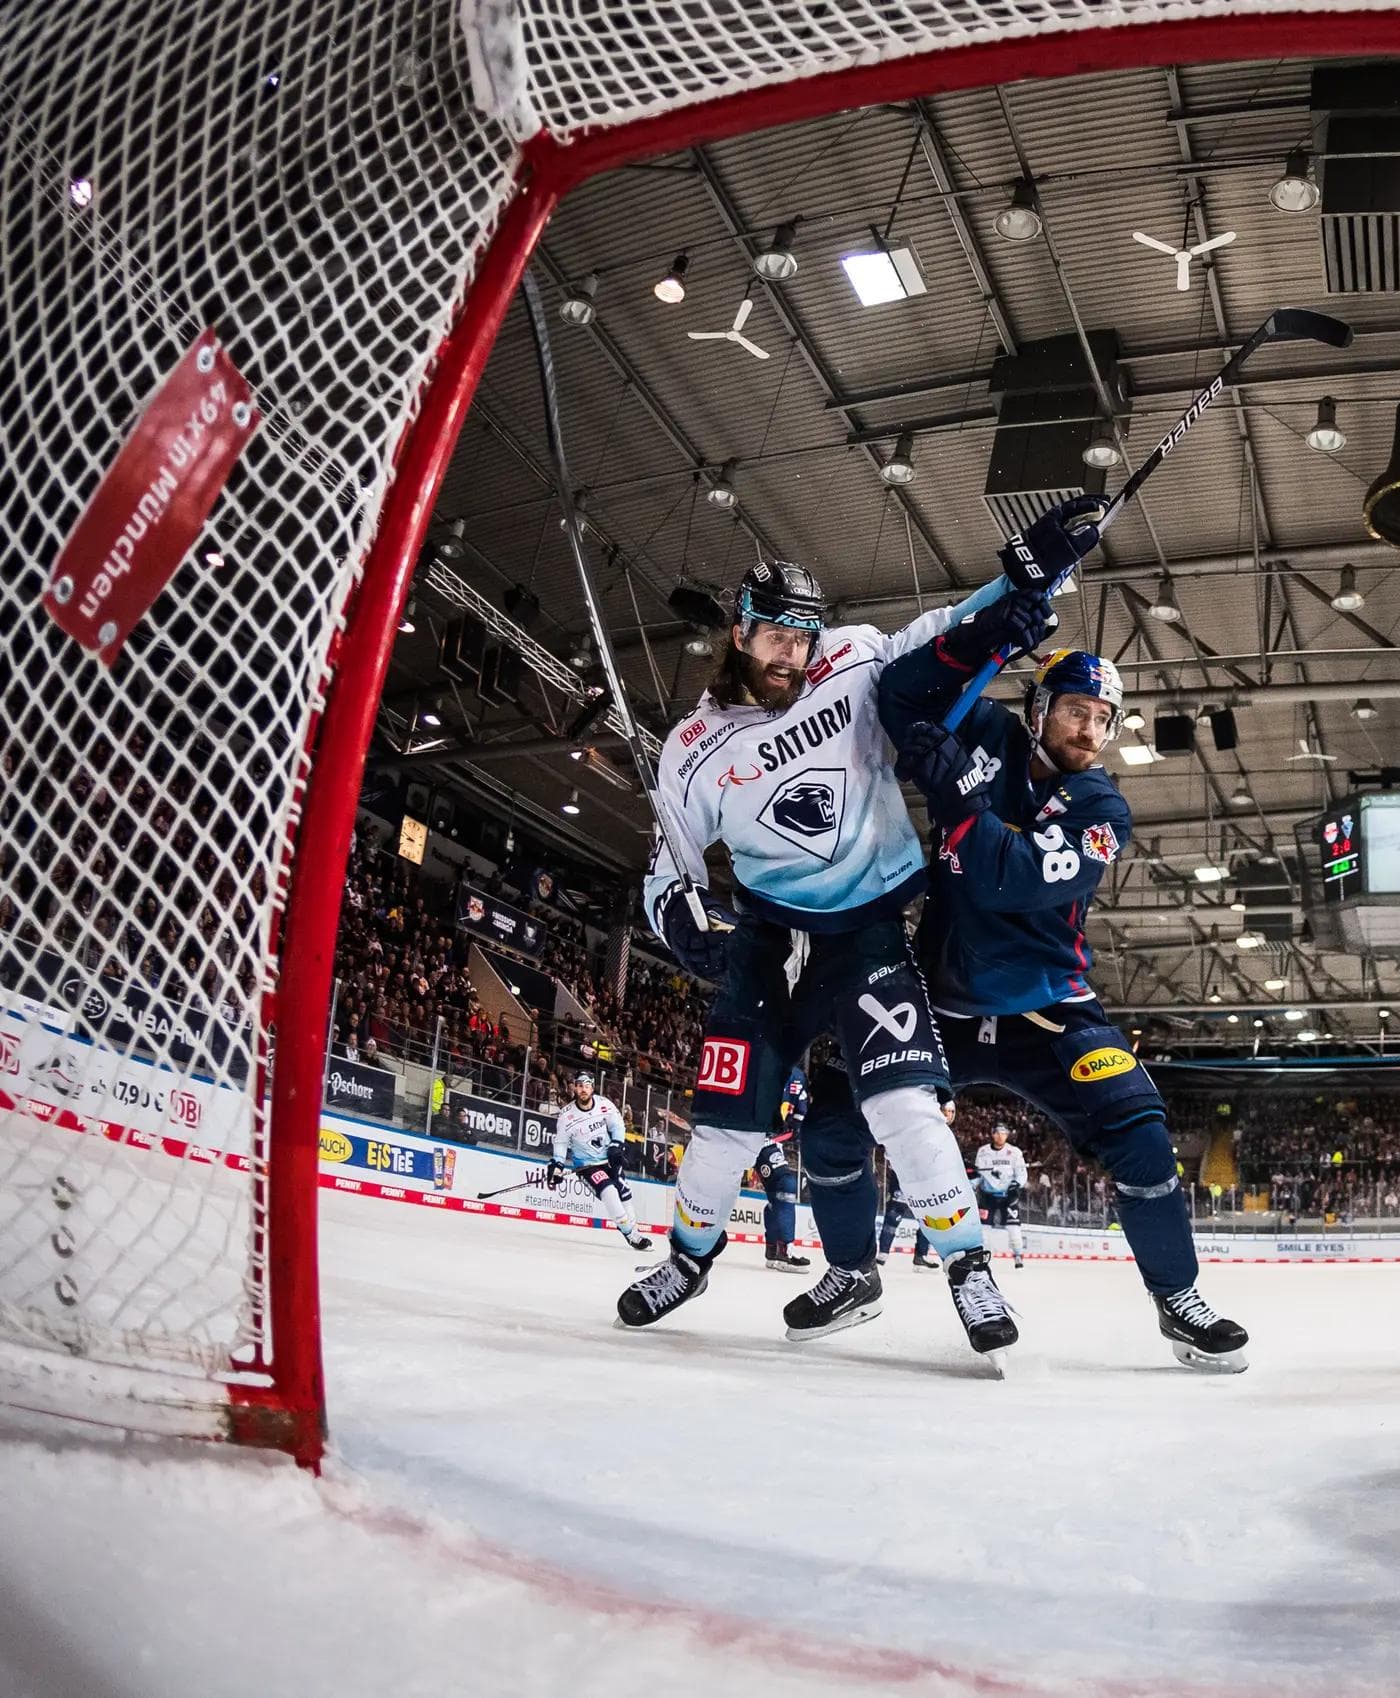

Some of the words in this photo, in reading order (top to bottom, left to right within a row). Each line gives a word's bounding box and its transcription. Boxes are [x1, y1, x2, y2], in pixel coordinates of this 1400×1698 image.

[169, 436, 199, 469] in
[79, 466, 179, 619] München
[682, 721, 705, 742] DB
[758, 694, 851, 772] SATURN
[677, 751, 699, 780] Regio
[699, 722, 735, 752] Bayern
[698, 1046, 739, 1084] DB
[860, 1050, 933, 1076] BAUER
[1088, 1055, 1129, 1072] RAUCH
[1277, 1243, 1311, 1252] SMILE
[1315, 1243, 1344, 1252] EYES
